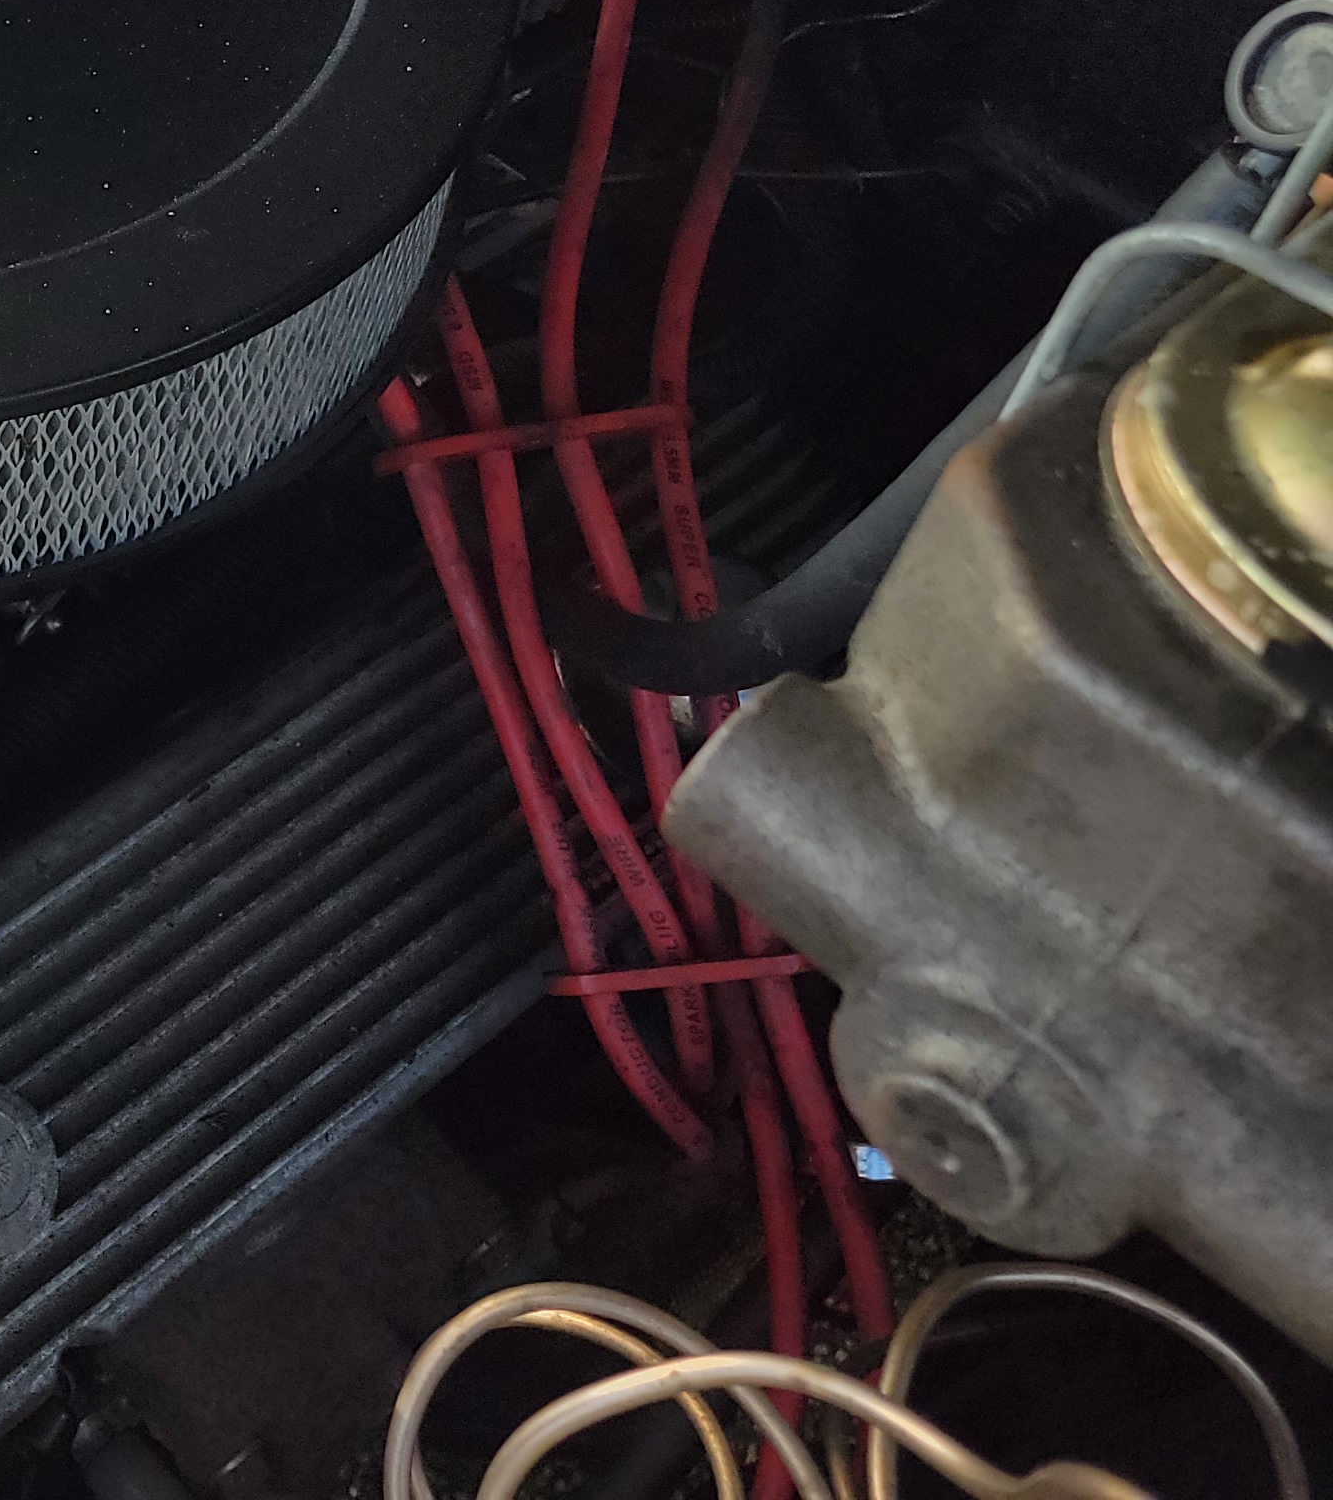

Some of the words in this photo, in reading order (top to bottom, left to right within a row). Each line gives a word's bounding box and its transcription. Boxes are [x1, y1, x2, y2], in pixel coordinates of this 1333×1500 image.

[673, 503, 702, 568] SUPER
[606, 834, 646, 888] WIRE
[679, 983, 706, 1046] SPARK
[609, 1001, 686, 1125] CONDUCTOR
